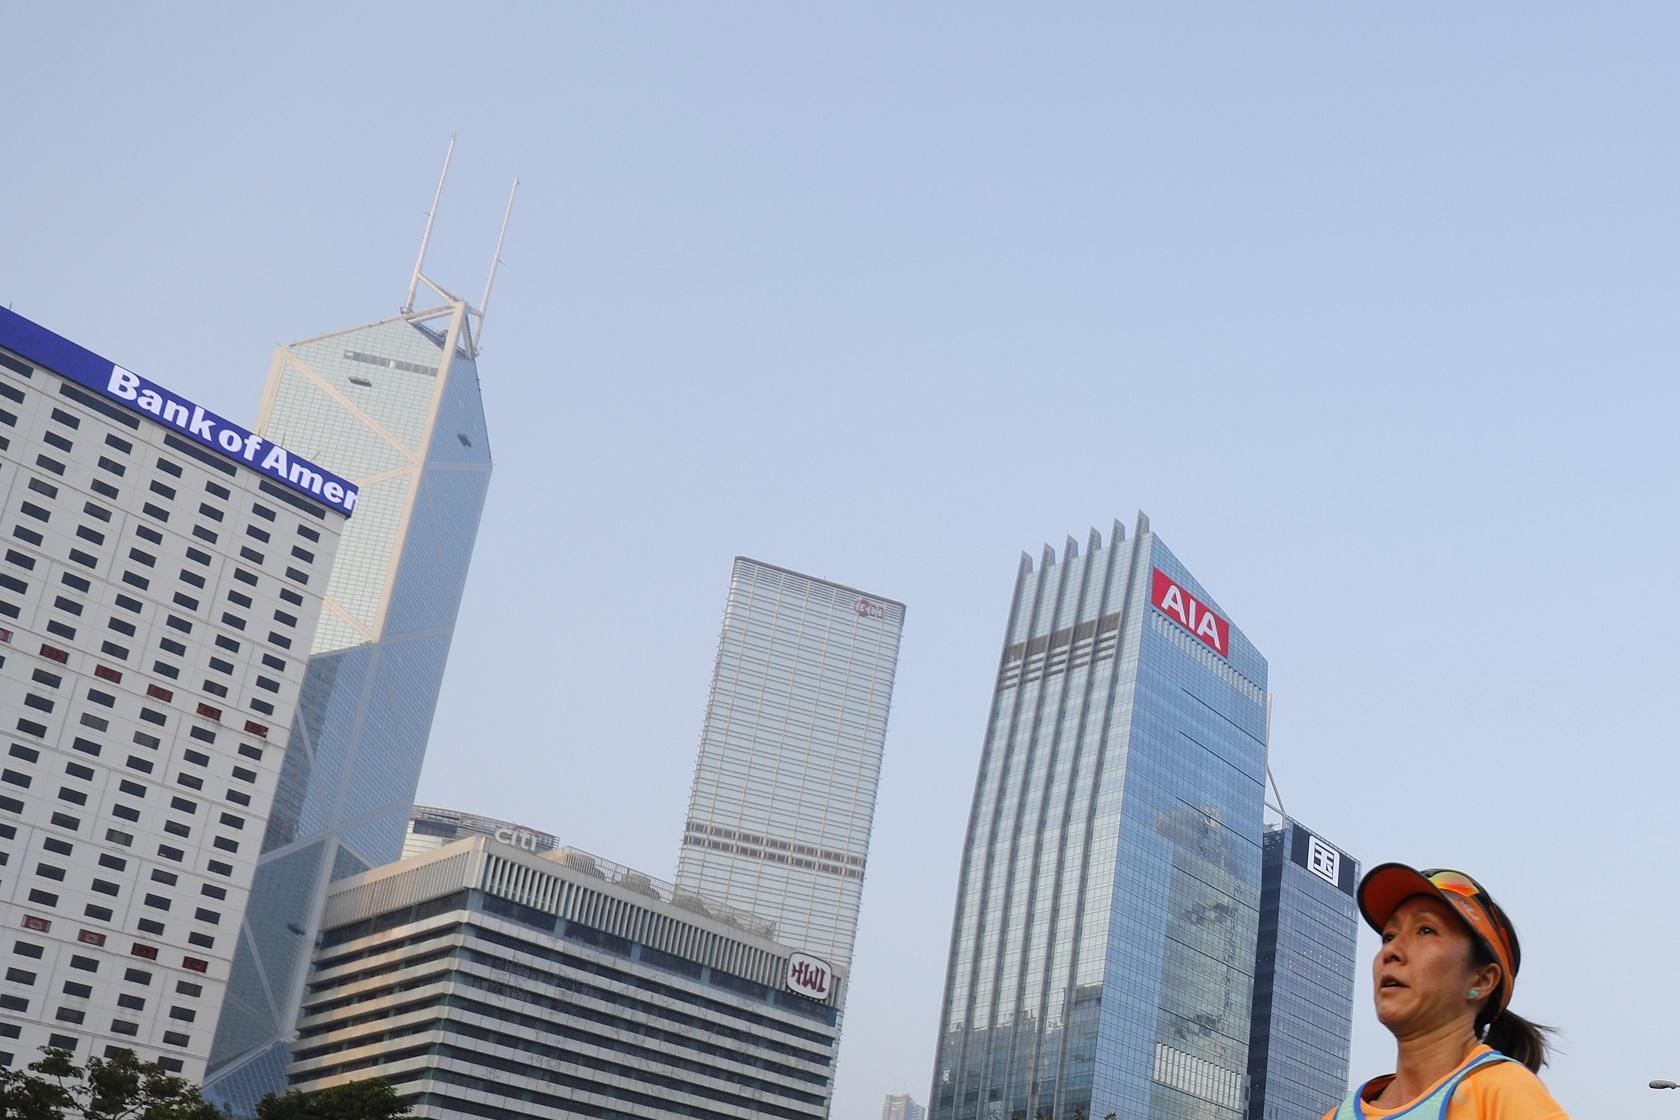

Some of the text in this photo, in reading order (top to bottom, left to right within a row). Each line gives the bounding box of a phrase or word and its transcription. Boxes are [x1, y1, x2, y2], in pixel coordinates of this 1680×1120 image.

[107, 364, 216, 441] Bank
[218, 429, 262, 461] of
[1160, 585, 1221, 651] AIA
[494, 827, 537, 852] citi
[790, 961, 827, 993] HWL
